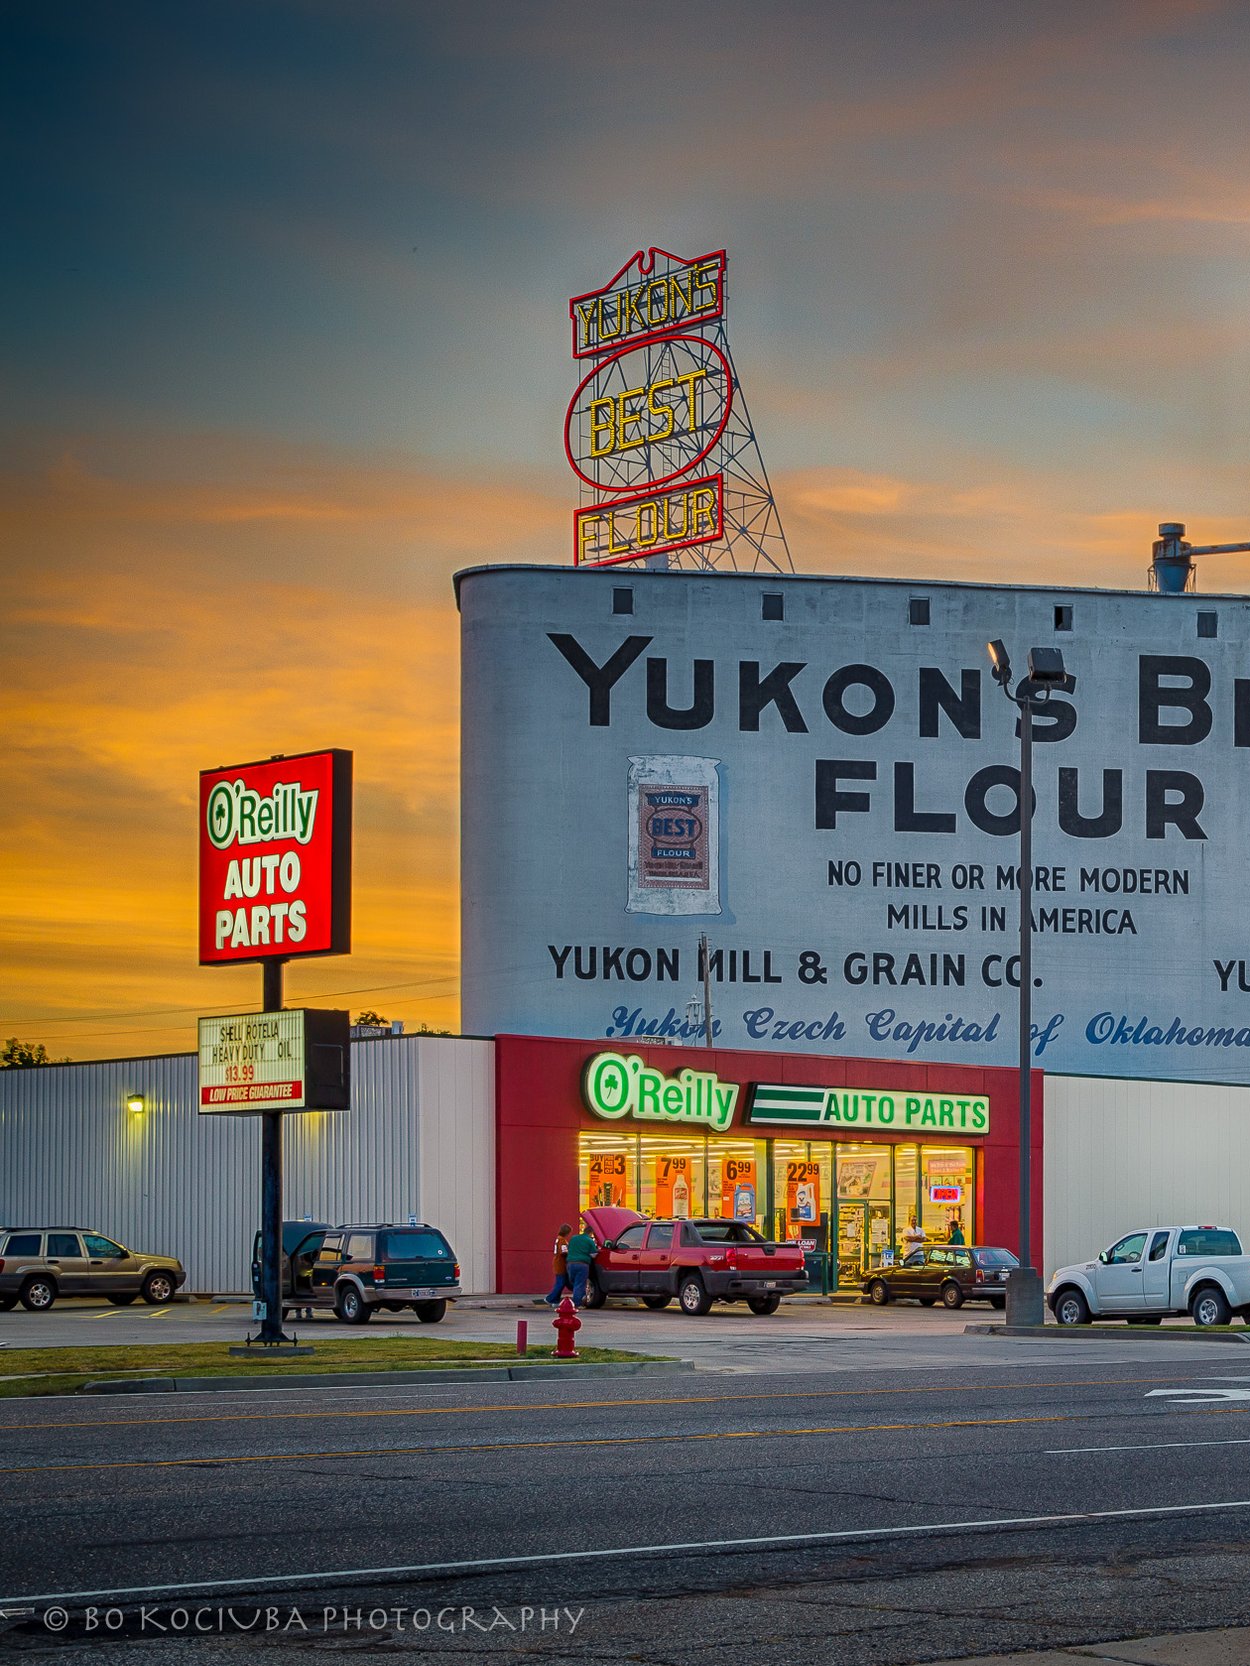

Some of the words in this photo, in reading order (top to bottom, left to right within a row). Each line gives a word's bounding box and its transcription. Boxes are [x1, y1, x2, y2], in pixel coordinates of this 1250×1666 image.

[590, 369, 706, 458] BEST
[579, 488, 717, 561] FLOUR
[208, 780, 317, 848] O'Reilly
[815, 759, 1208, 840] FLOUR
[652, 818, 697, 837] BEST
[657, 850, 691, 858] FLOUR
[224, 851, 301, 900] AUTO
[828, 860, 861, 887] NO
[872, 861, 941, 889] FINER
[951, 862, 985, 890] OR
[996, 865, 1066, 892] MORE
[1080, 868, 1189, 895] MODERN
[215, 900, 307, 949] PARTS
[887, 904, 968, 931] MILLS
[981, 906, 1006, 932] IN
[548, 945, 680, 982] YUKON
[697, 948, 782, 984] MILL
[798, 950, 828, 985] &
[843, 952, 966, 986] GRAIN
[982, 954, 1043, 988] CO.
[220, 1025, 242, 1042] SHELL
[246, 1022, 279, 1041] ROTELLA
[606, 1005, 722, 1039] Yukon
[743, 1007, 846, 1041] Czech
[865, 1008, 1000, 1054] Capital
[1029, 1013, 1065, 1056] of
[212, 1044, 240, 1063] HEAVY
[242, 1043, 265, 1060] DUTY
[278, 1041, 291, 1058] OIL
[225, 1064, 254, 1081] $13.99
[209, 1088, 227, 1102] LOW
[226, 1086, 249, 1101] PRICE
[249, 1084, 293, 1099] GUARANTEE
[590, 1055, 737, 1129] O'Reilly
[824, 1093, 895, 1124] AUTO
[905, 1098, 986, 1129] PARTS
[615, 1154, 625, 1175] 3
